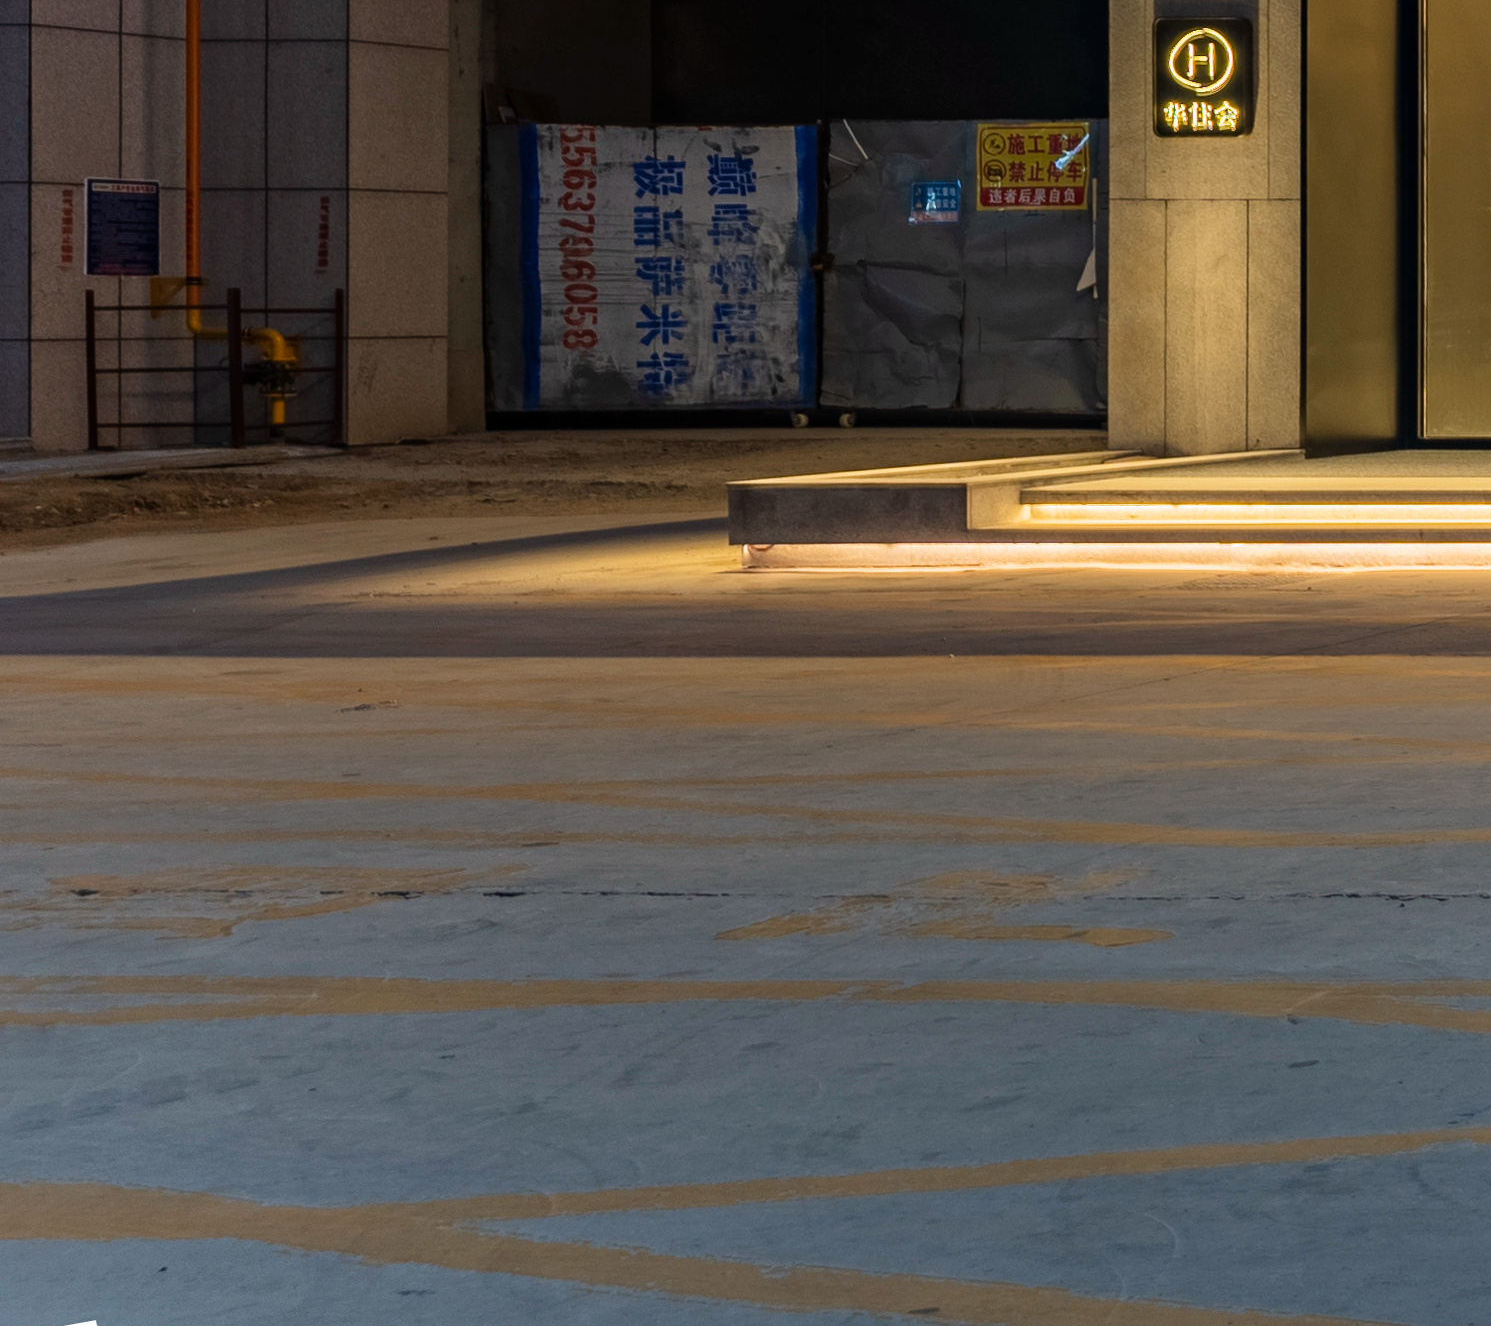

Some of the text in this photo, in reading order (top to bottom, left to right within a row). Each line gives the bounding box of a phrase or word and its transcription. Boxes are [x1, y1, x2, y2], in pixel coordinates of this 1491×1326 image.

[1008, 160, 1083, 184] 禁止停车
[988, 188, 1077, 205] 违者后果自负
